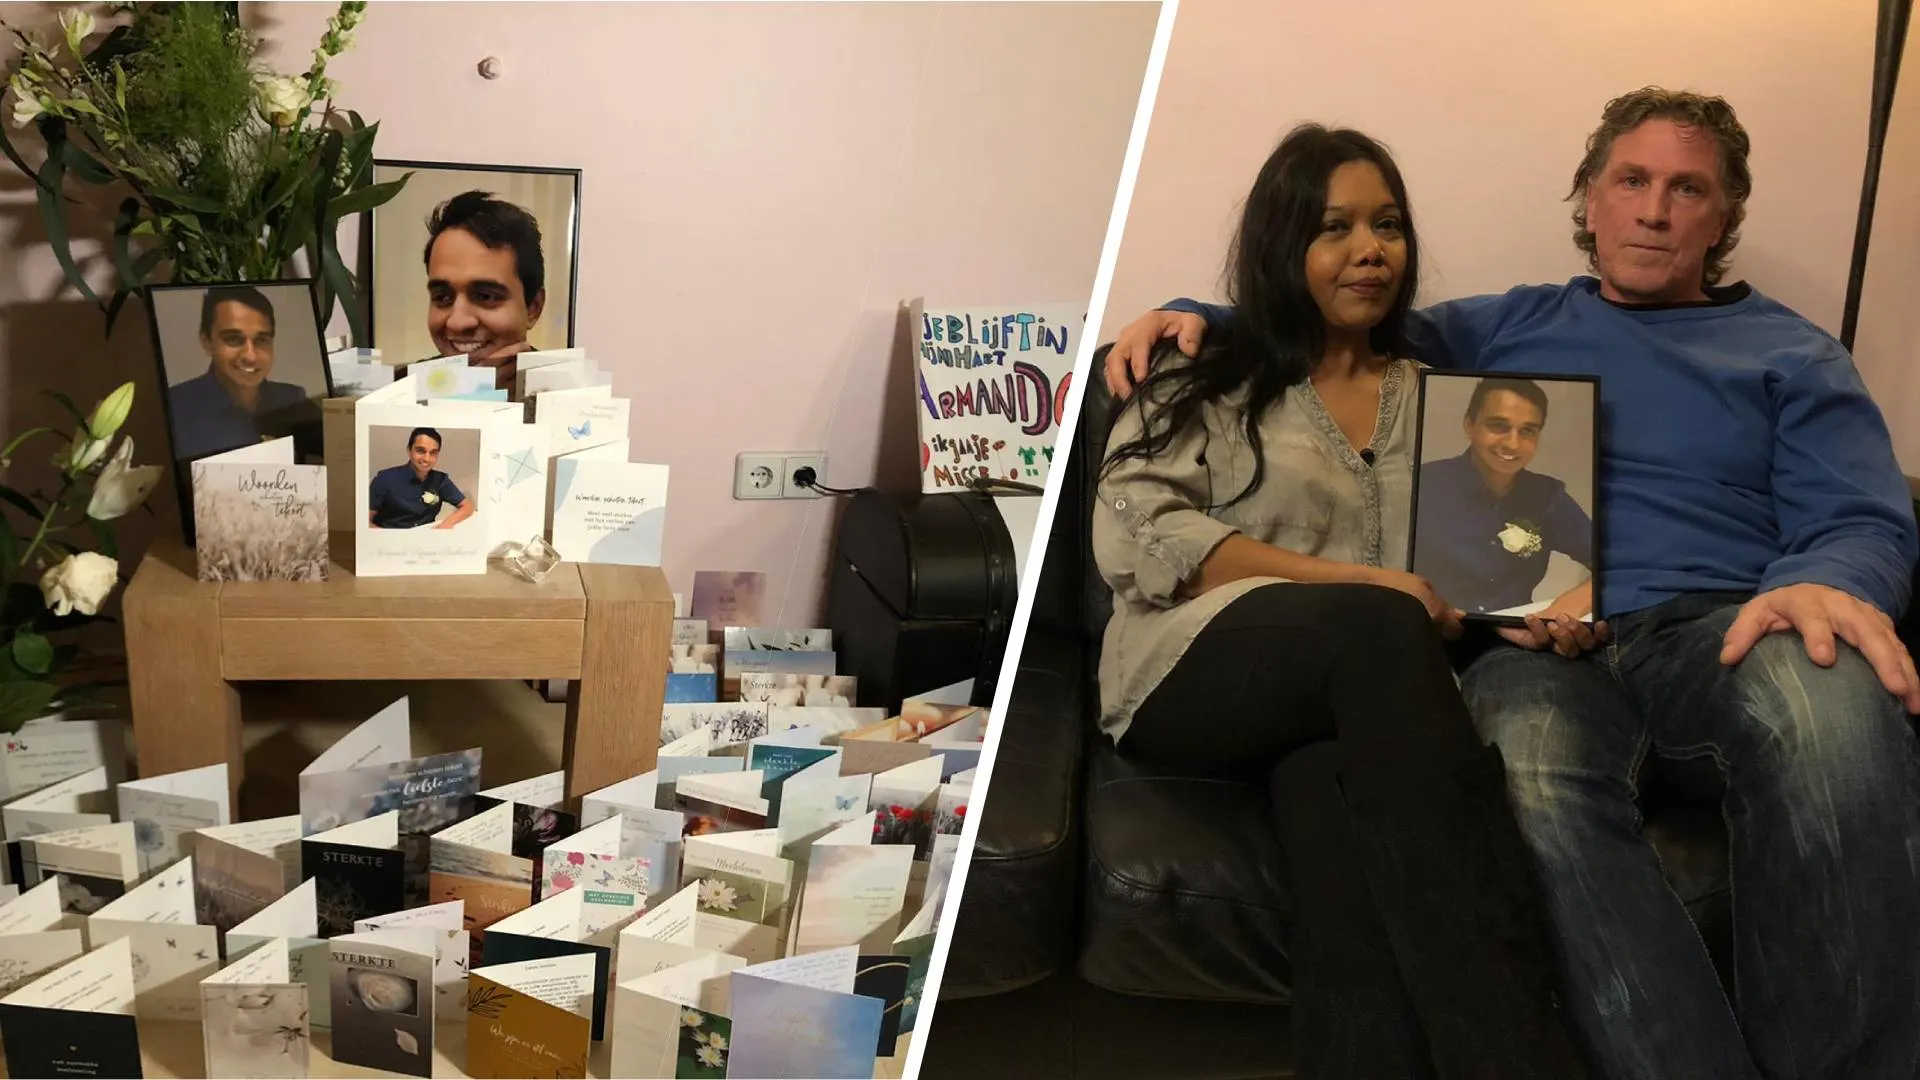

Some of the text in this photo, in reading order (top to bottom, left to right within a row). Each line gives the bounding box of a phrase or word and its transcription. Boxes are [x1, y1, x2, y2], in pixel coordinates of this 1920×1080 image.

[238, 469, 298, 493] Woorden
[322, 850, 384, 868] STERKTE
[331, 951, 397, 969] STERKTE
